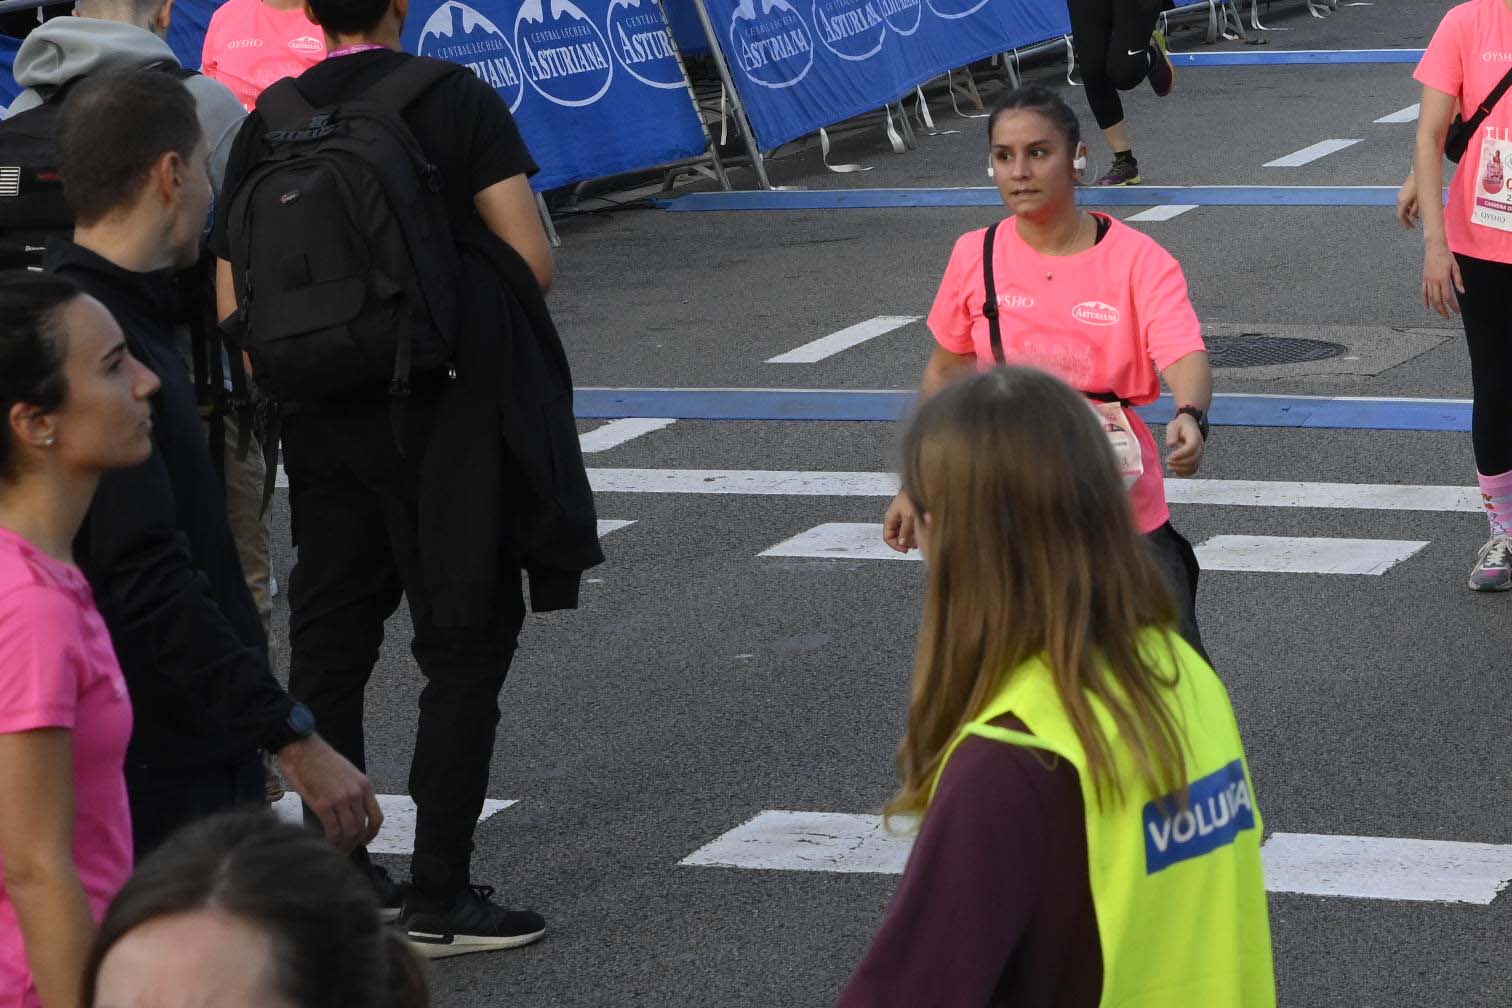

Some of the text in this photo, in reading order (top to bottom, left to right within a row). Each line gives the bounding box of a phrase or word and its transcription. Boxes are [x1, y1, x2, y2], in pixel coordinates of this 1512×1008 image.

[531, 25, 591, 43] CENTRAL LECHERA
[438, 39, 503, 59] CENTRAL LECHERA
[523, 36, 609, 81] ASTURIANA
[1481, 212, 1505, 223] OYSHO
